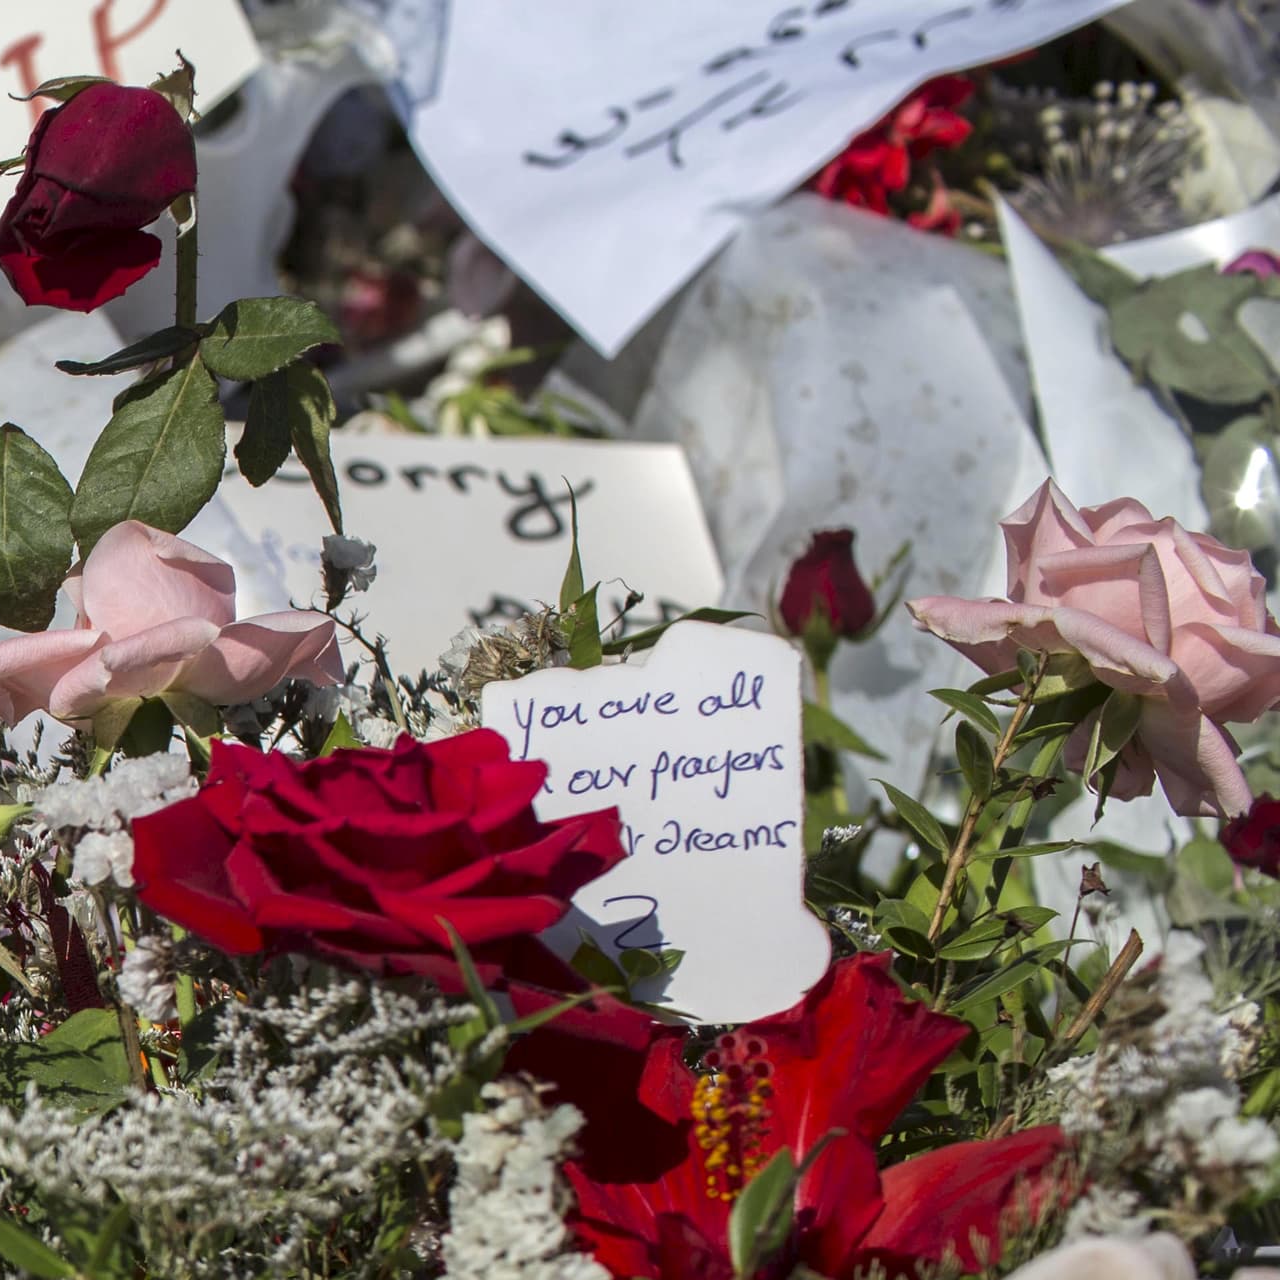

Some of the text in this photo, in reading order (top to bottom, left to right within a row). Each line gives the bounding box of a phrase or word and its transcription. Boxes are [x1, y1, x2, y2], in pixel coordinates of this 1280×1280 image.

[223, 456, 595, 542] orry
[599, 691, 680, 719] are
[698, 671, 764, 717] all
[567, 763, 638, 794] our
[650, 744, 784, 800] prayers
[654, 820, 797, 855] dreams
